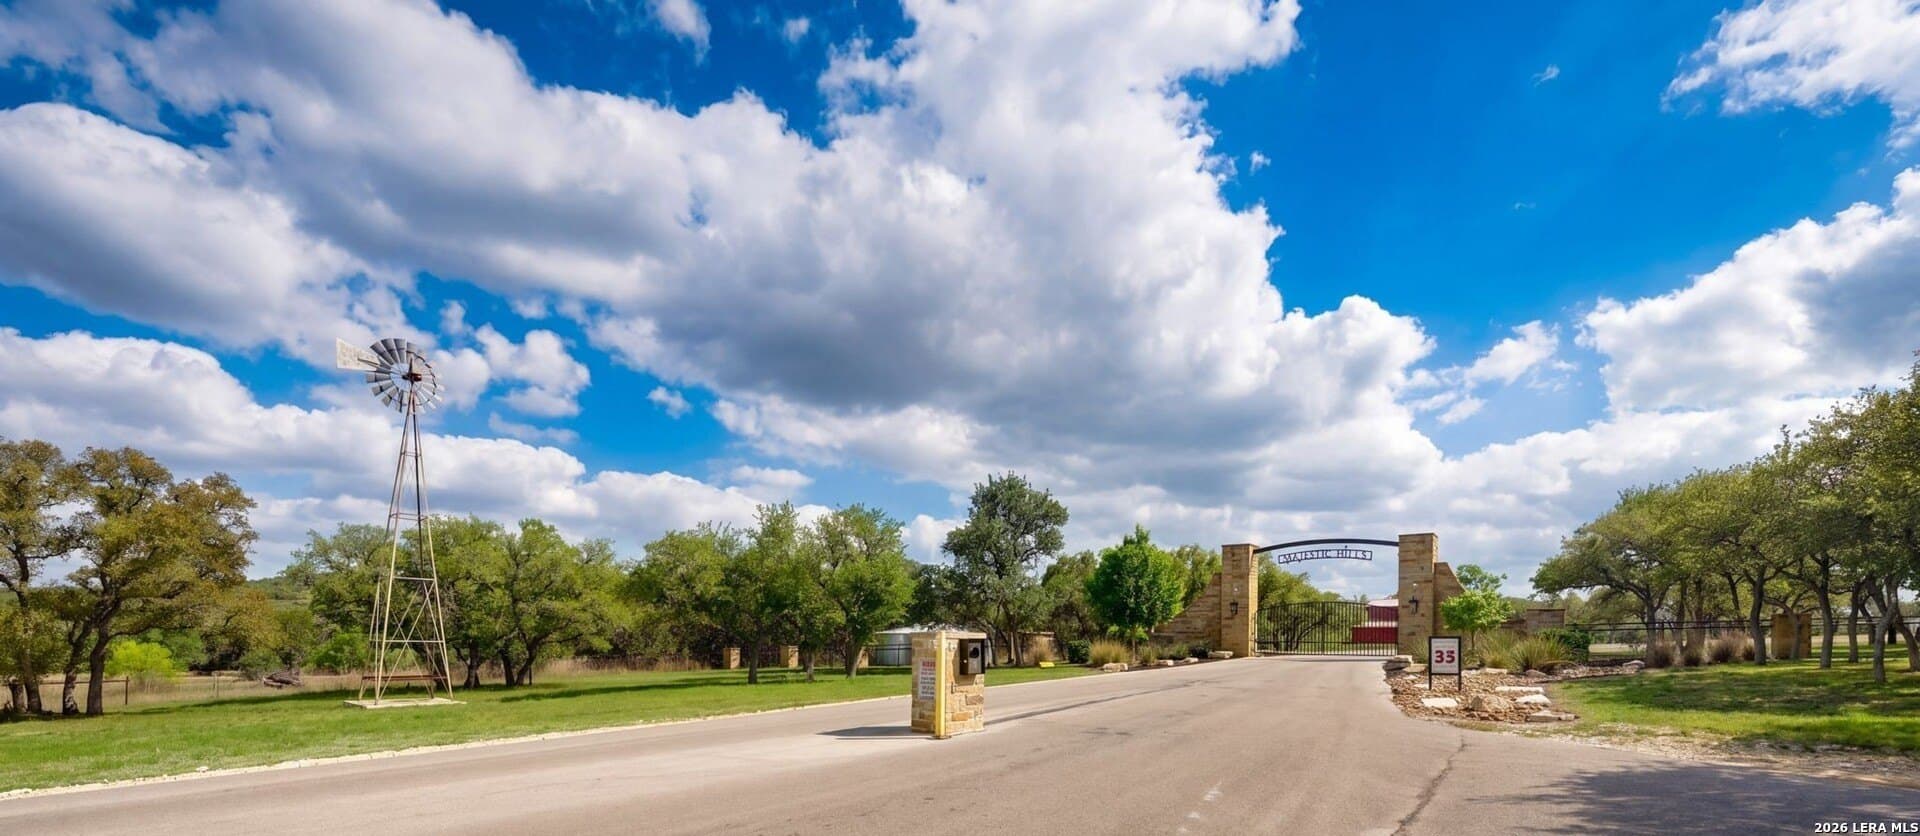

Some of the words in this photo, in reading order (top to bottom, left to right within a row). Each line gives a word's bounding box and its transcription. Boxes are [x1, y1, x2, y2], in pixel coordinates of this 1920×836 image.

[1283, 549, 1331, 563] MAJESTIC
[1336, 549, 1367, 560] HILLS
[1434, 649, 1456, 664] 35
